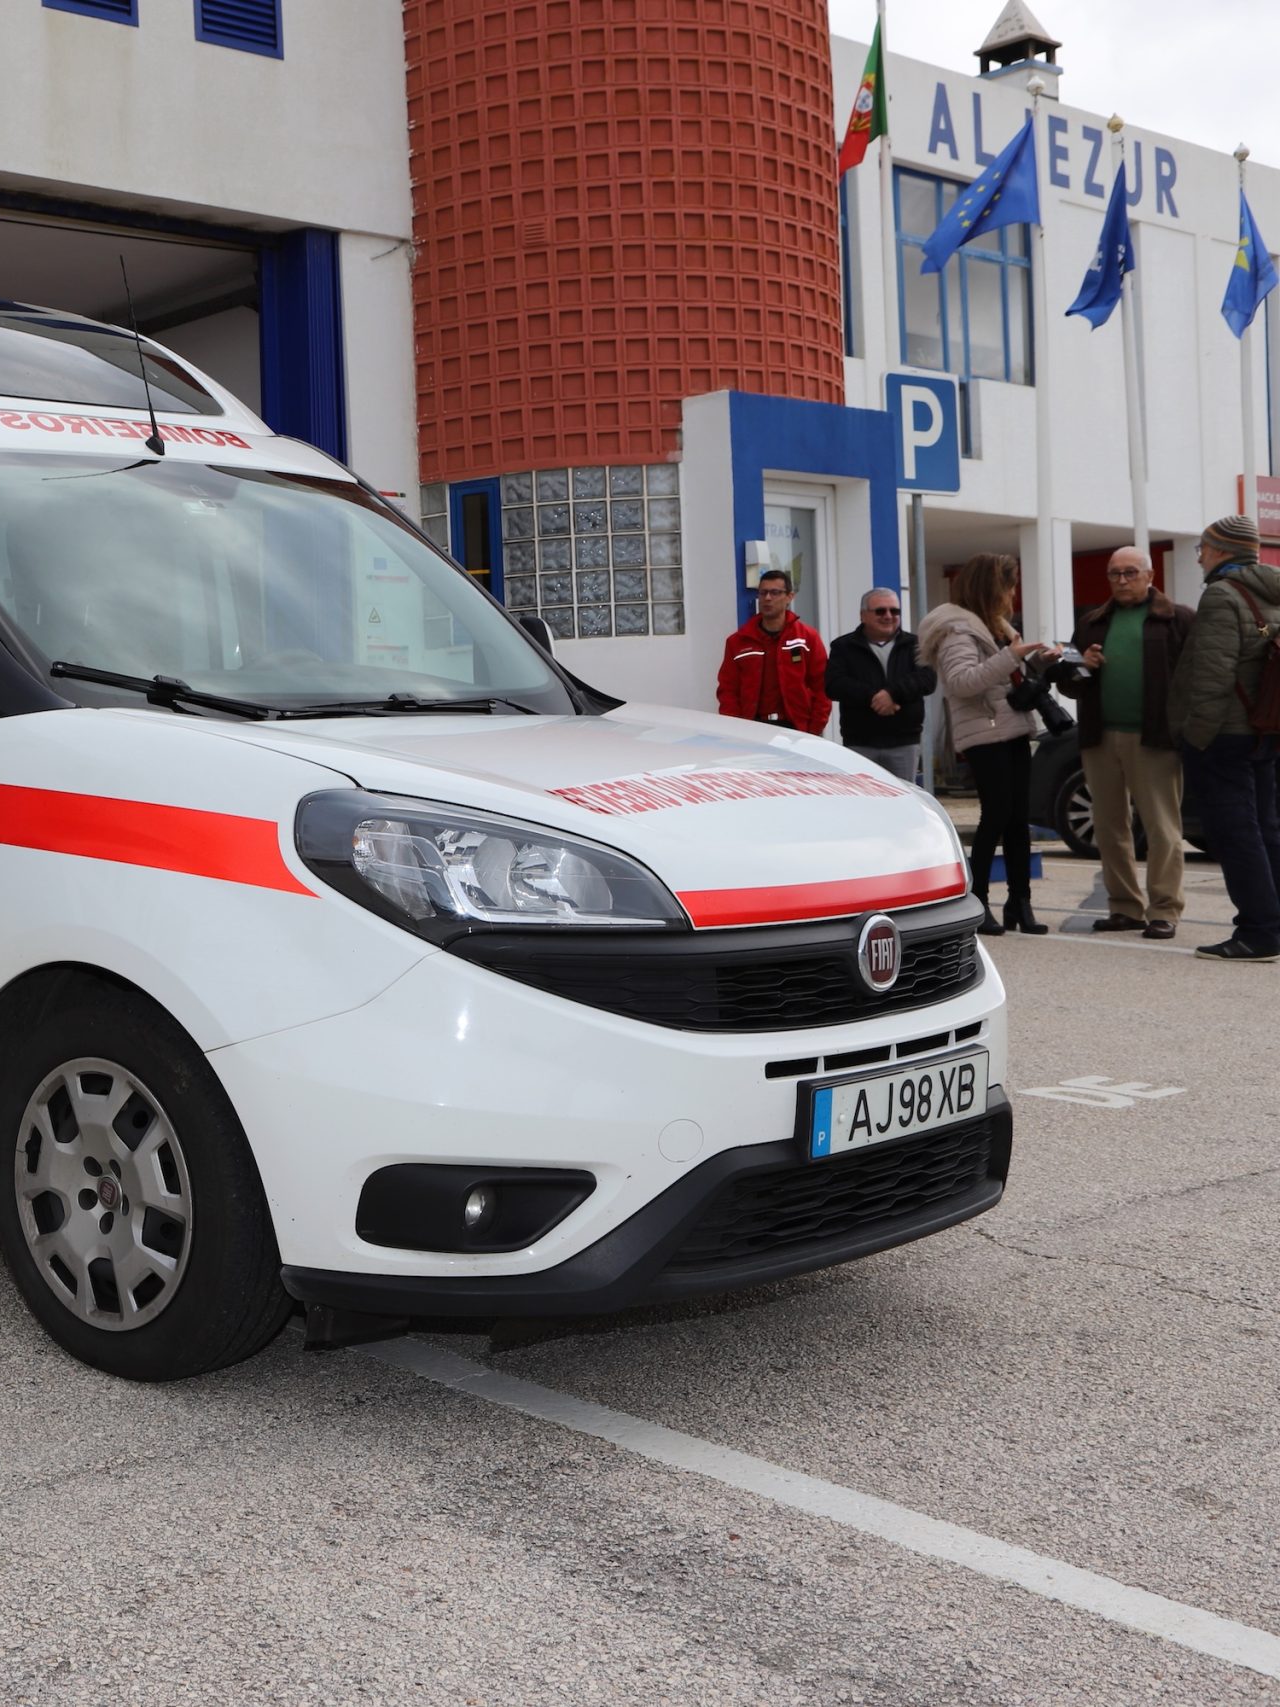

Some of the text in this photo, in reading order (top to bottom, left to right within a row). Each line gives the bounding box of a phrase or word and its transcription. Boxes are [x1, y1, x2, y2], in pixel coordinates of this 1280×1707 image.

[928, 82, 1180, 219] ALEZUR
[900, 384, 944, 480] P
[871, 937, 894, 972] FIAT
